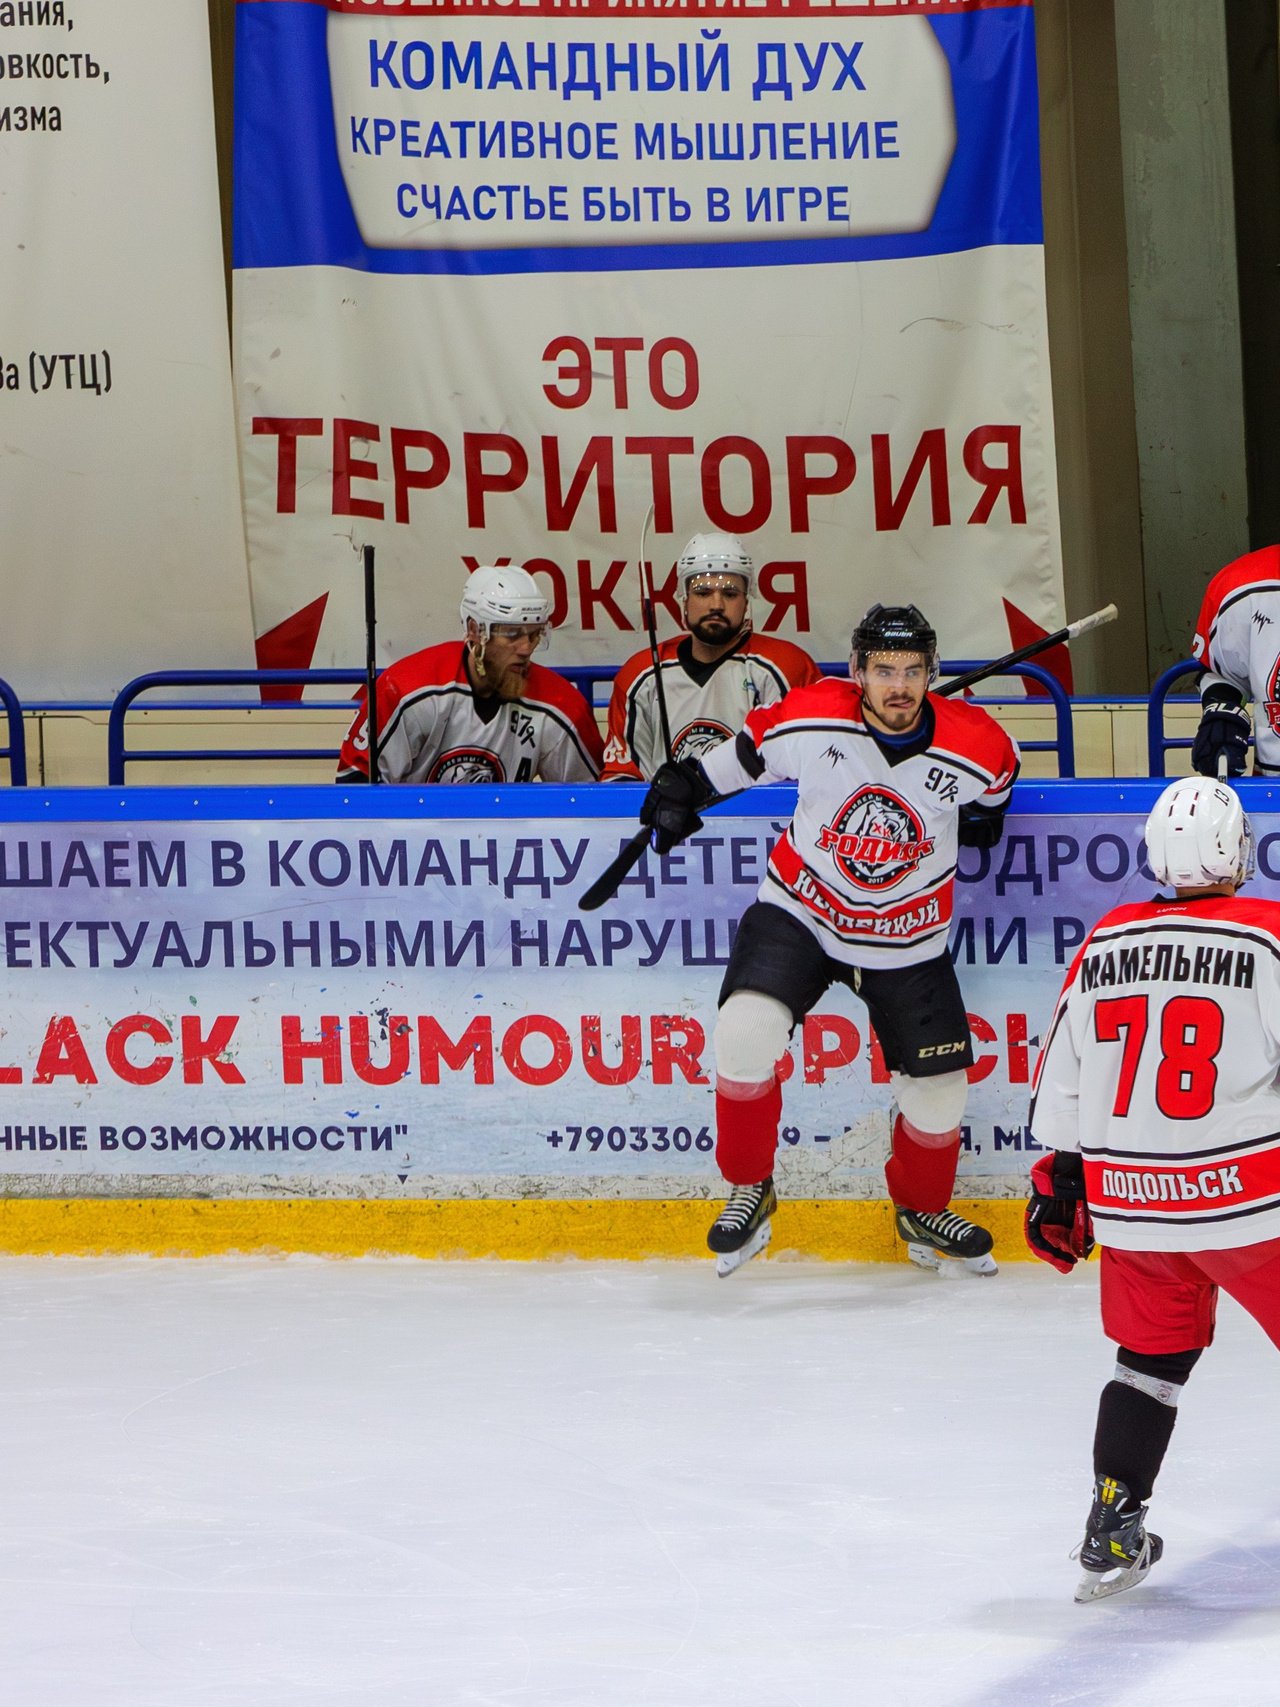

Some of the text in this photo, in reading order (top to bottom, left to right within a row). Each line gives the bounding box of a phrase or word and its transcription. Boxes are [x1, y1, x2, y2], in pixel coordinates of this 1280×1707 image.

[369, 29, 866, 101] КОМАНДНЫЙ ДУХ
[351, 116, 899, 161] КРЕАТИВНОЕ МЫШЛЕНИЕ
[397, 183, 849, 222] СЧАСТЬЕ БЫТЬ В ИГРЕ
[29, 350, 111, 395] (УТЦ)
[542, 336, 699, 410] ЭТО
[253, 415, 1027, 534] ТЕРРИТОРИЯ
[873, 822, 892, 839] ХК
[210, 840, 246, 888] В
[268, 837, 590, 899] КОМАНДУ
[5, 919, 485, 968] ЕКТУАЛЬНЫМИ
[1081, 944, 1255, 993] МАМЕЛЬКИН
[283, 1014, 711, 1086] HUMOUR
[918, 1040, 966, 1059] CCM
[1095, 995, 1223, 1120] 78
[100, 1123, 409, 1152] ВОЗМОЖНОСТИ"
[1102, 1164, 1244, 1204] ПОДОЛЬСК
